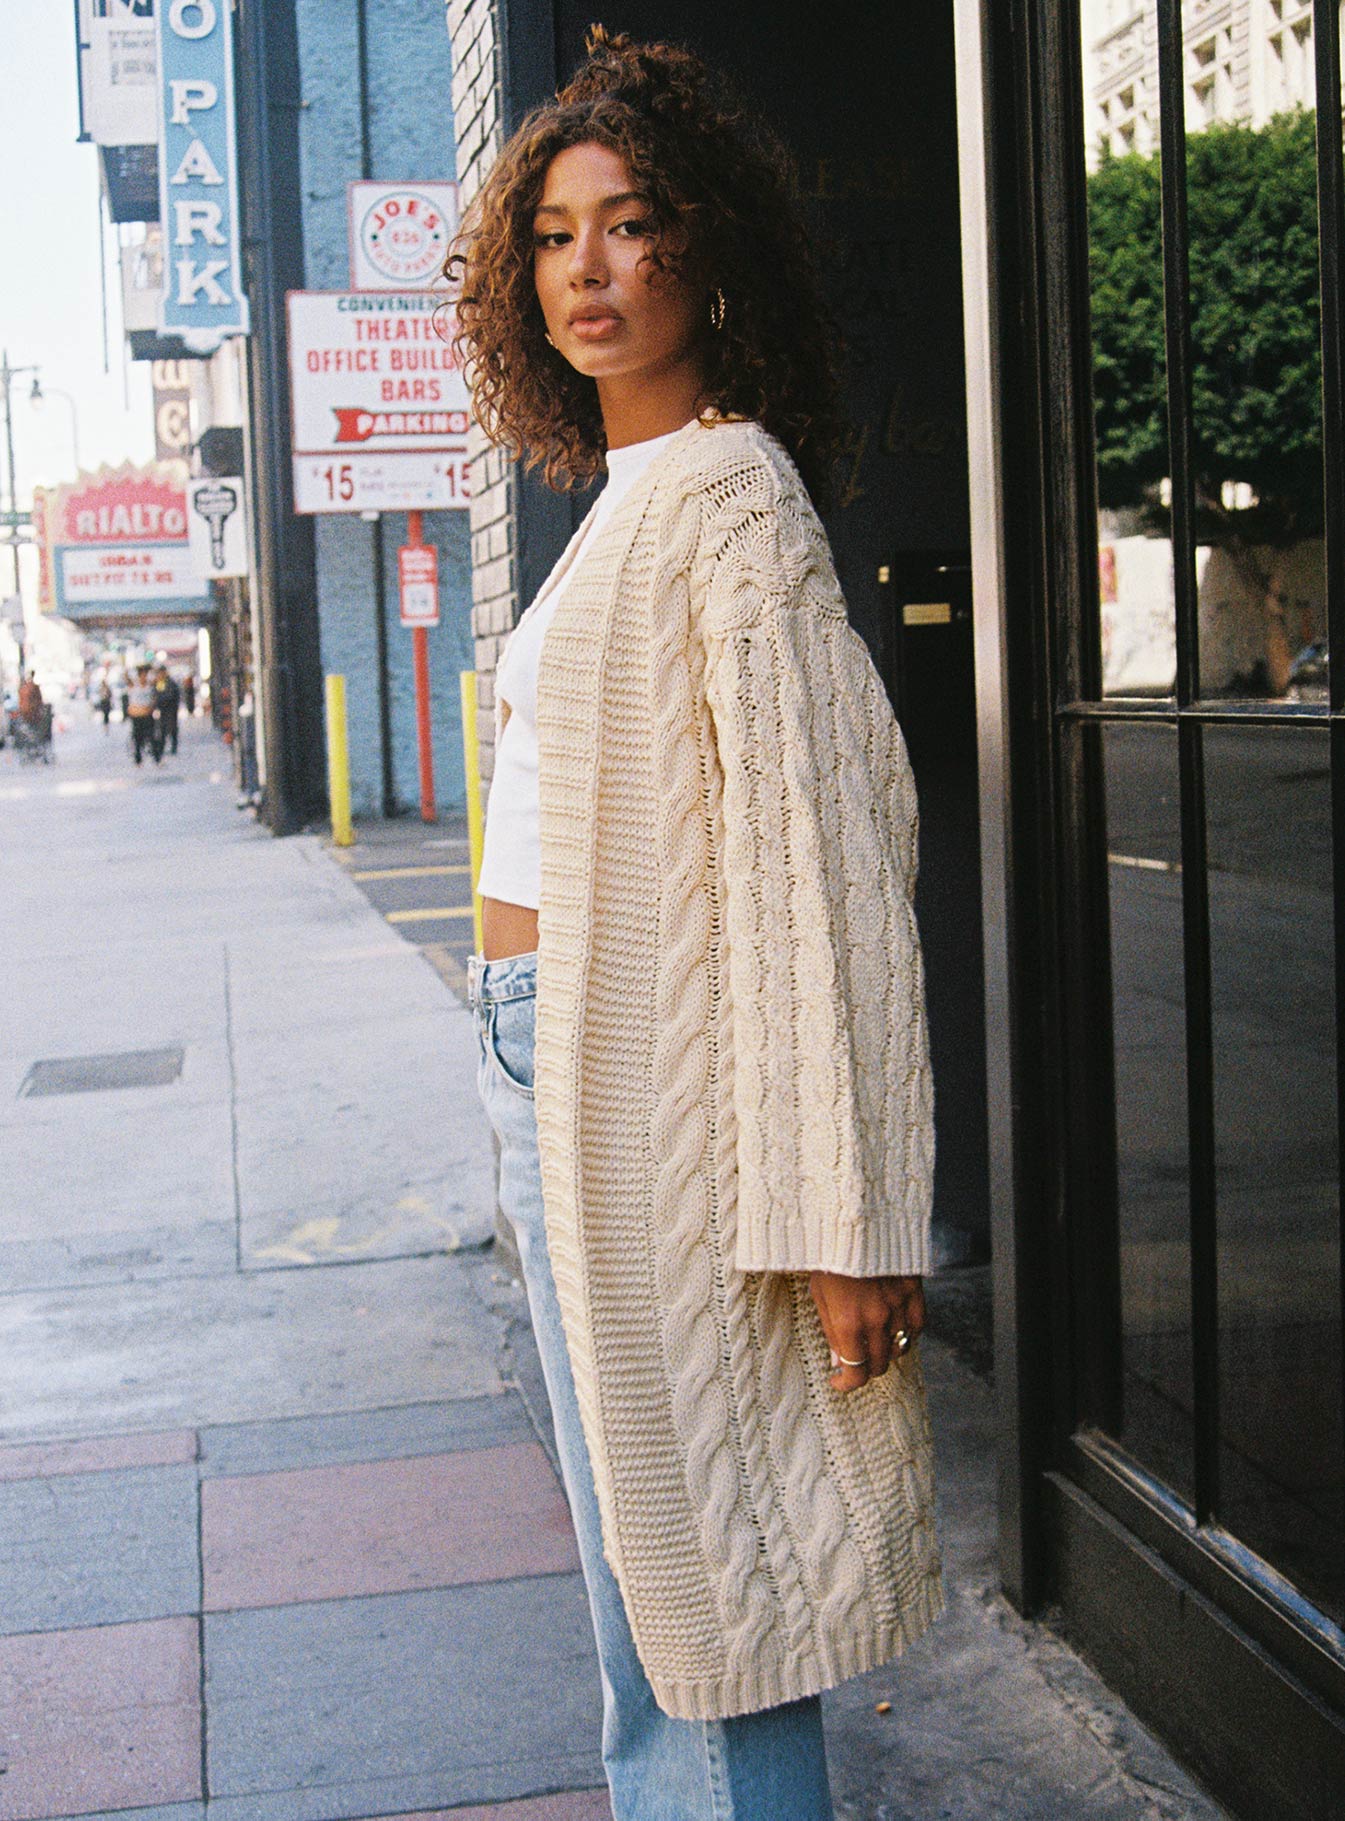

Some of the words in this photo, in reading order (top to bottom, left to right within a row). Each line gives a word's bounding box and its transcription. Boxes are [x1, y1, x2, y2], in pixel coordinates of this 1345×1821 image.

[169, 80, 231, 305] PARK
[307, 350, 379, 373] OFFICE
[381, 379, 441, 401] BARS
[356, 413, 467, 434] PARKING
[76, 503, 184, 537] RIALTO
